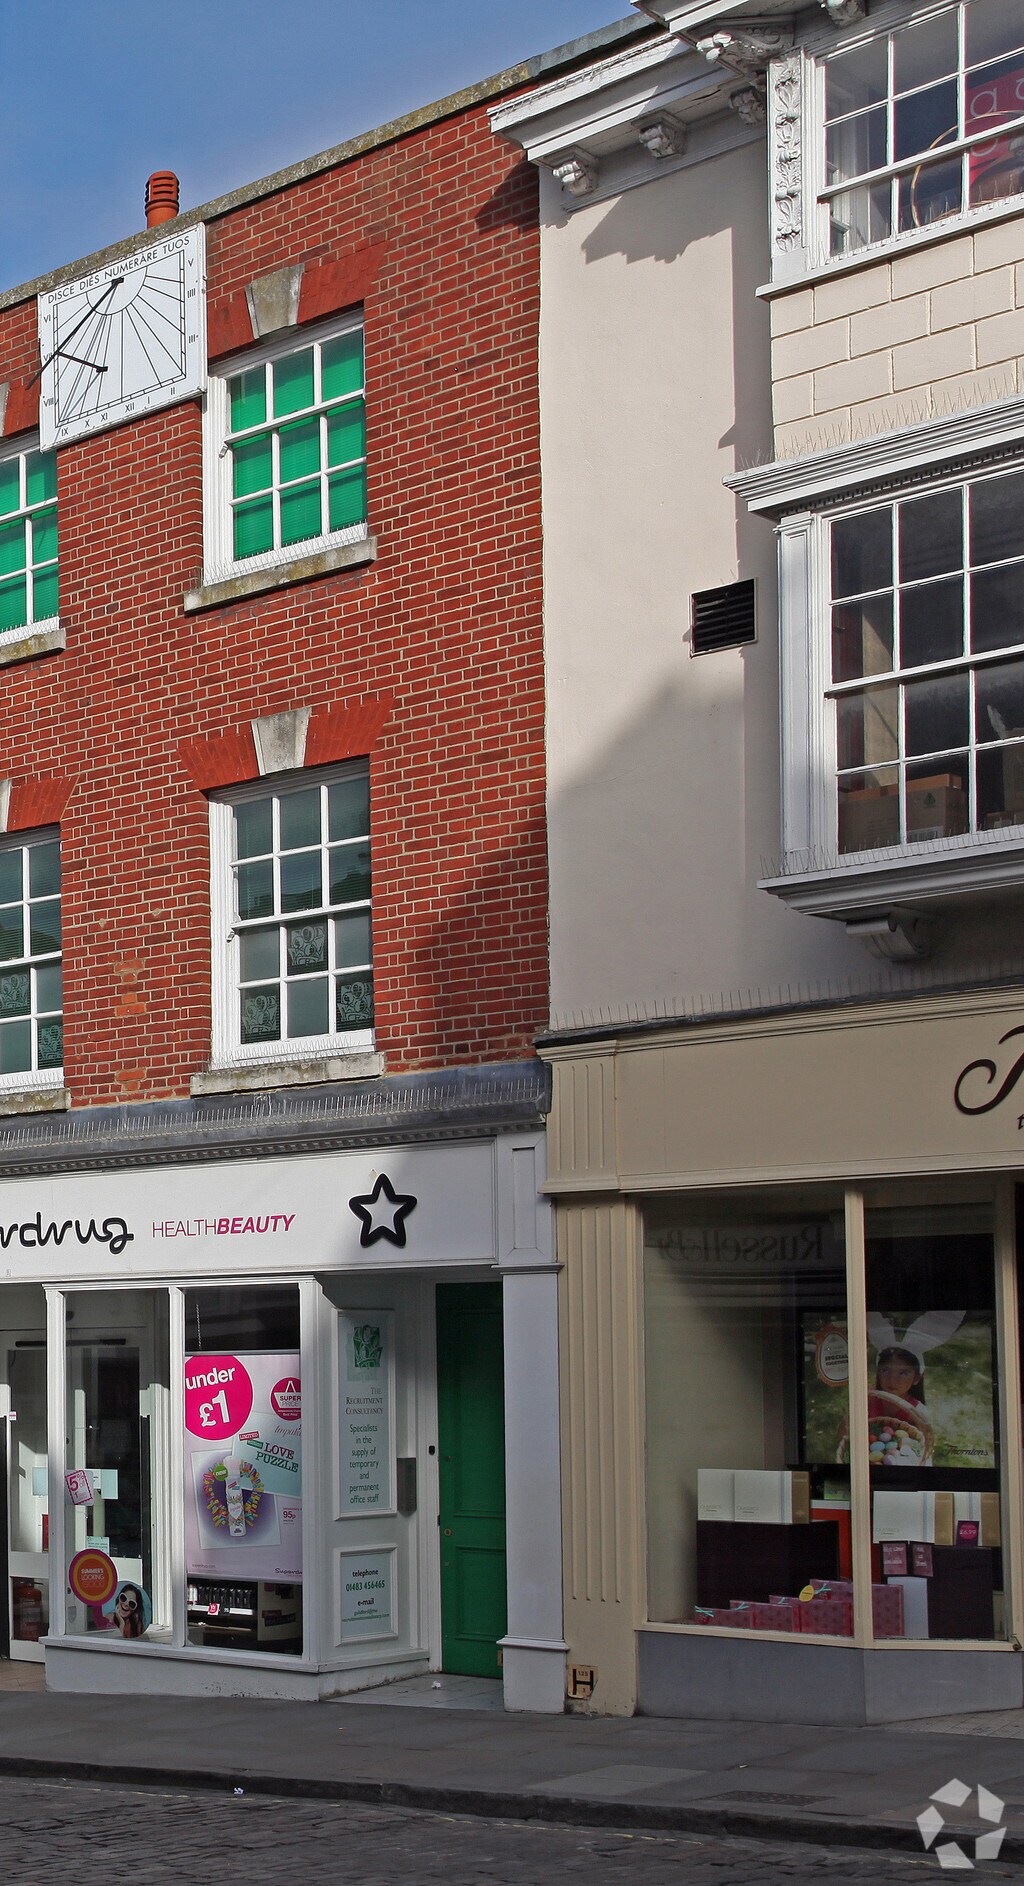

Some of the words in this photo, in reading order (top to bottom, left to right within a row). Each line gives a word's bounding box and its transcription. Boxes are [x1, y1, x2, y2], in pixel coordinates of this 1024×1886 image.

[188, 258, 194, 267] V
[48, 286, 75, 304] DISCE
[80, 276, 100, 291] DIES
[104, 250, 158, 280] NUMERARE
[162, 236, 190, 254] TUOS
[124, 402, 134, 413] XII
[100, 412, 108, 422] XI
[84, 420, 90, 428] X
[61, 428, 69, 437] IX
[151, 1214, 296, 1239] HEALTHBEAUTY
[186, 1367, 235, 1390] under
[200, 1390, 230, 1428] £1
[349, 1424, 378, 1434] Specialists
[264, 1442, 294, 1460] LOVE
[352, 1449, 368, 1458] supply
[370, 1447, 376, 1455] of
[944, 1443, 988, 1456] Thorntons
[255, 1451, 298, 1473] PUZZLE
[350, 1460, 379, 1470] temporary
[349, 1484, 379, 1493] permanent
[350, 1496, 366, 1504] office
[367, 1494, 379, 1502] staff
[283, 1511, 296, 1519] 95p
[352, 1569, 378, 1578] telephone
[346, 1582, 362, 1592] 01483
[358, 1598, 374, 1606] e-mail
